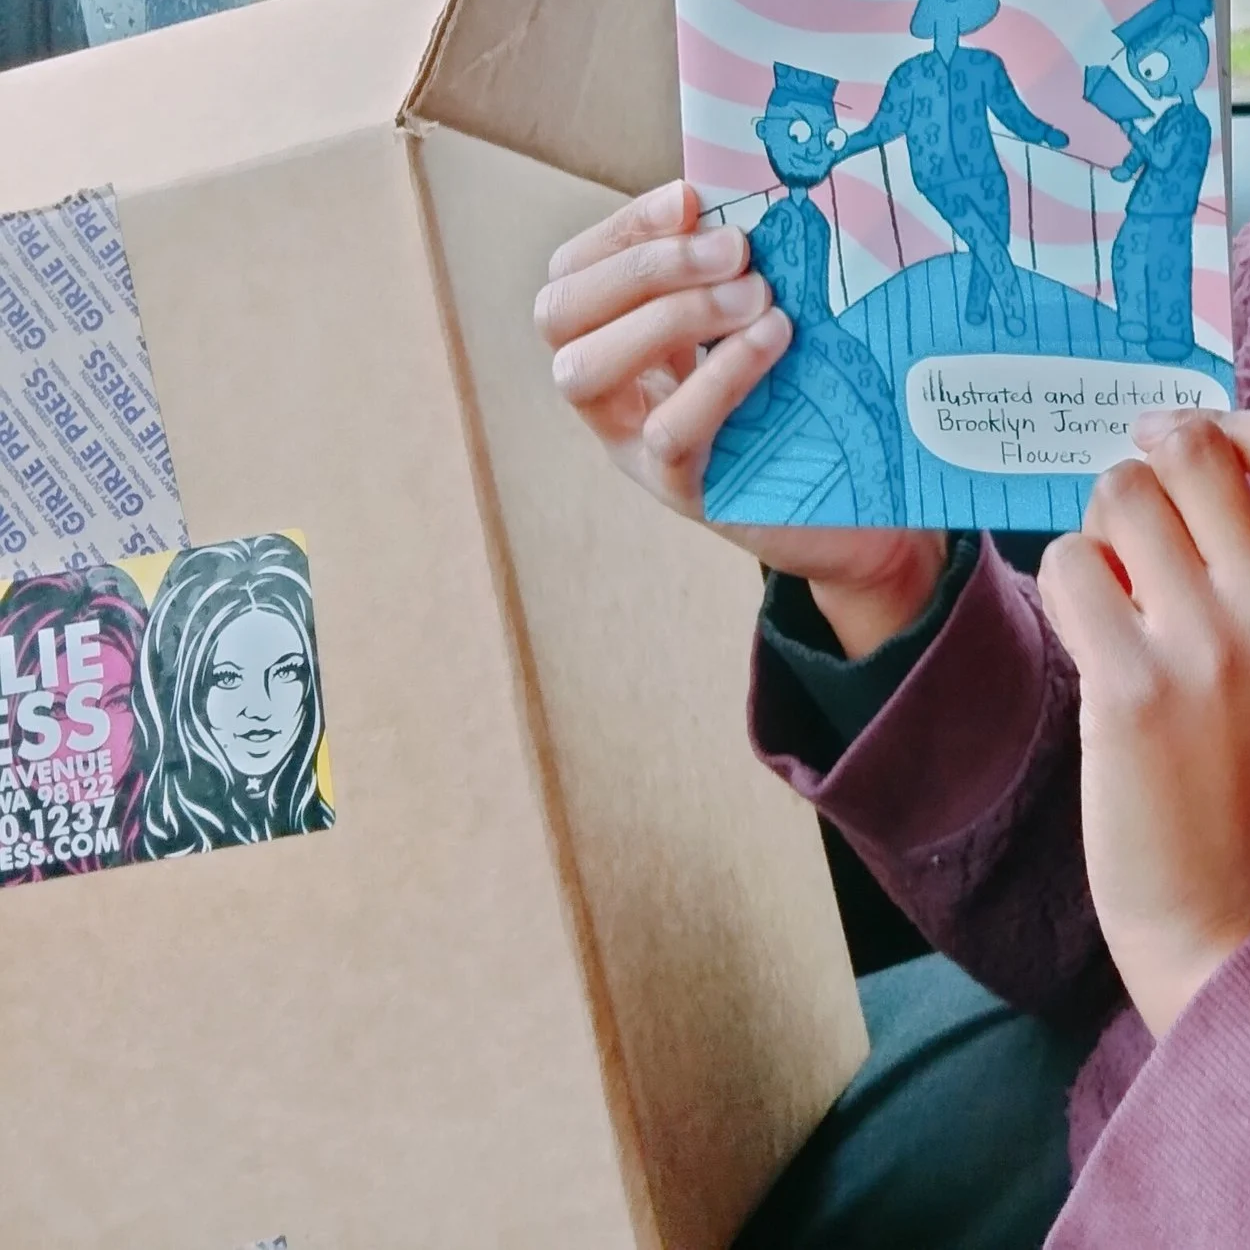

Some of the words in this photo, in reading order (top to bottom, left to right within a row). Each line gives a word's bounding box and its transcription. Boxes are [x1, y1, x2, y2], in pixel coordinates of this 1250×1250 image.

[0, 212, 51, 259] PRE
[0, 275, 49, 352] GIRLI
[40, 256, 106, 334] GIRLIE
[22, 364, 90, 443] PRESS
[80, 346, 148, 425] PRESS
[1044, 377, 1085, 406] and
[1095, 379, 1166, 407] edited
[1175, 380, 1202, 409] by
[937, 408, 1035, 438] Brooklyn
[1051, 408, 1130, 436] Jamer
[1001, 441, 1092, 466] Flowers
[19, 456, 89, 538] GIRLIE
[78, 438, 147, 520] GIRLIE
[0, 619, 104, 695] LIE
[0, 682, 111, 766] ESS
[0, 749, 112, 792] AVENUE
[37, 774, 115, 808] 98122
[0, 795, 116, 846] 0.1237
[0, 827, 120, 871] ESS.COM
